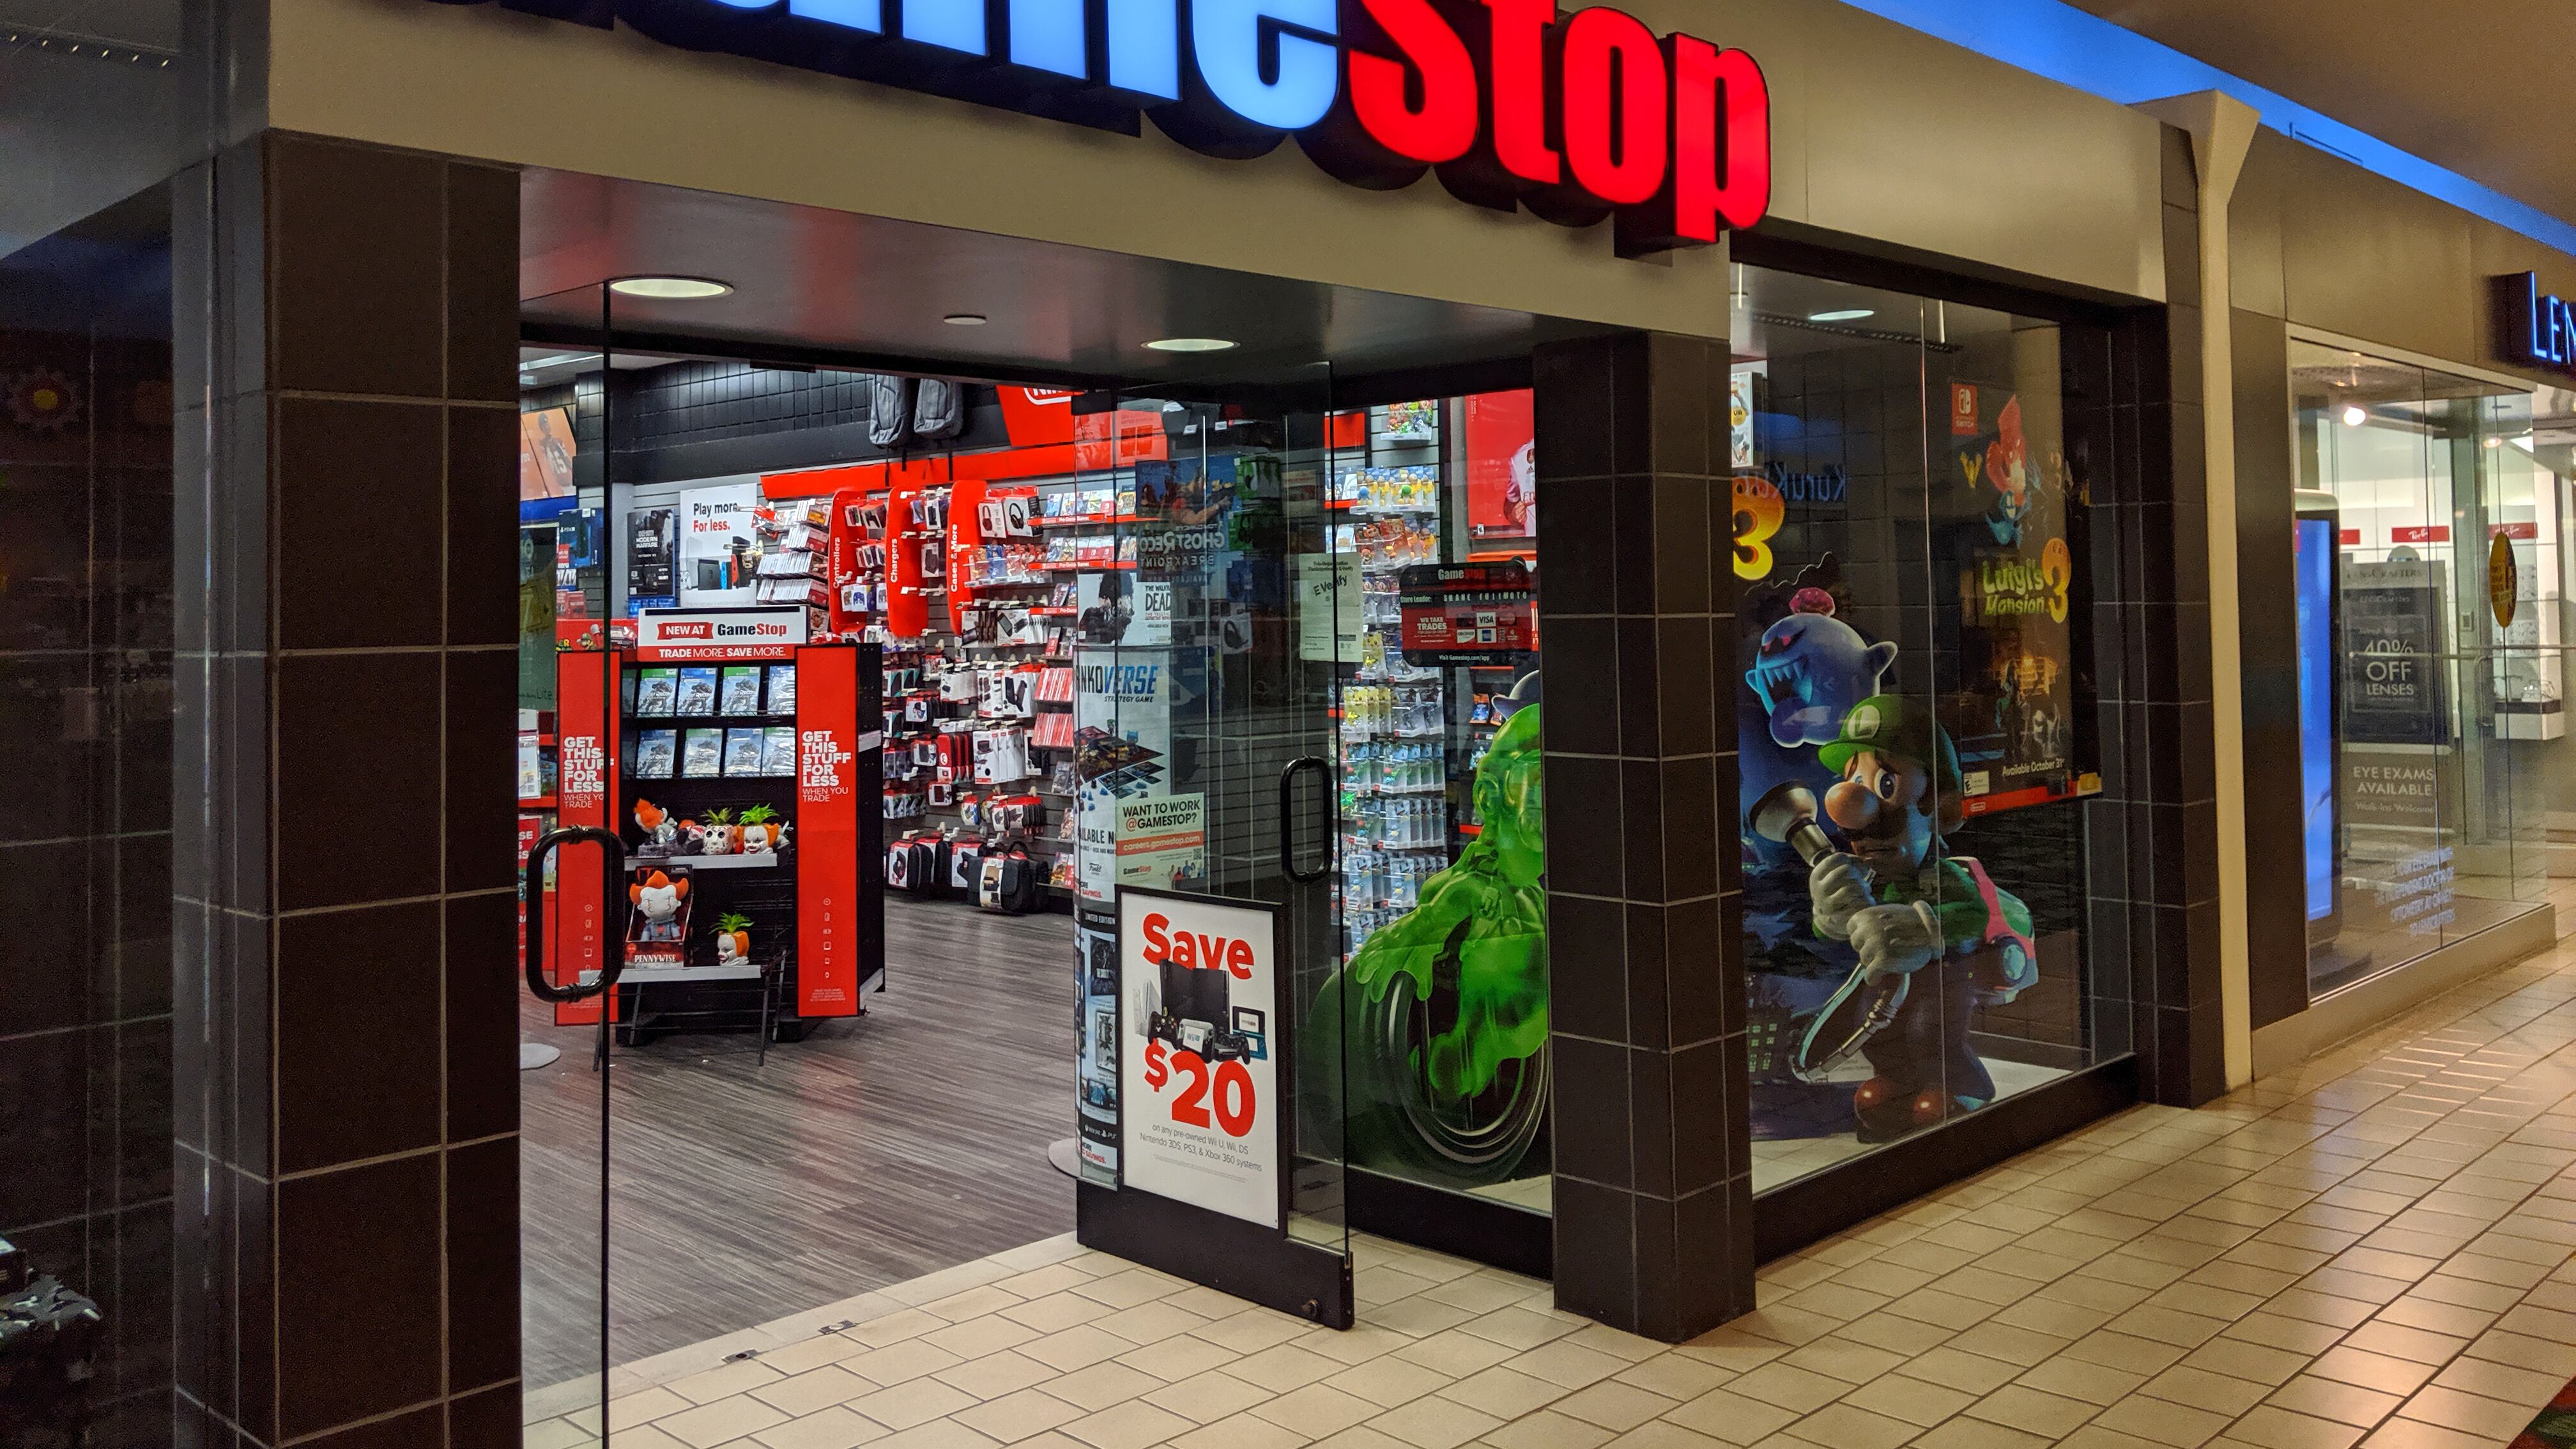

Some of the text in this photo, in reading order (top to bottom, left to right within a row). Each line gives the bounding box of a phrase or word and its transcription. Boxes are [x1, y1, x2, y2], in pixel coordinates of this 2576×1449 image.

[717, 0, 1770, 243] eStop
[693, 503, 712, 518] Play
[693, 519, 730, 532] For less.
[1982, 537, 2072, 624] Luigi's 3
[1984, 594, 2044, 616] Mansion
[1479, 615, 1494, 624] VISA
[666, 623, 786, 637] NEW AT GameStop
[659, 647, 786, 658] TRADE MORE. SAVE MORE.
[2366, 661, 2411, 681] OFF
[2366, 683, 2414, 696] LENSES
[564, 737, 595, 747] GET
[802, 731, 832, 742] GET
[564, 747, 601, 759] THIS
[802, 742, 838, 753] THIS
[802, 752, 852, 764] STUFF
[564, 770, 597, 781] FOR
[803, 764, 834, 775] FOR
[2002, 763, 2030, 777] Available
[2031, 760, 2055, 772] October
[2353, 767, 2434, 781] EYE EXAMS
[565, 781, 604, 793] LESS
[803, 775, 839, 786] LESS
[2358, 782, 2433, 796] AVAILABLE
[1123, 799, 1200, 818] WANT TO WORK
[1126, 812, 1197, 832] @GAMESTOP?
[1142, 912, 1254, 980] Save
[634, 954, 677, 963] PENNYWISE
[1144, 1038, 1255, 1138] $20
[1162, 1126, 1172, 1137] any
[1173, 1129, 1206, 1144] pre-owned
[1238, 1144, 1248, 1155] DS
[1140, 1132, 1167, 1146] Nintendo
[1204, 1149, 1222, 1161] Xbox
[1222, 1153, 1235, 1165] 360
[1236, 1157, 1263, 1172] systems
